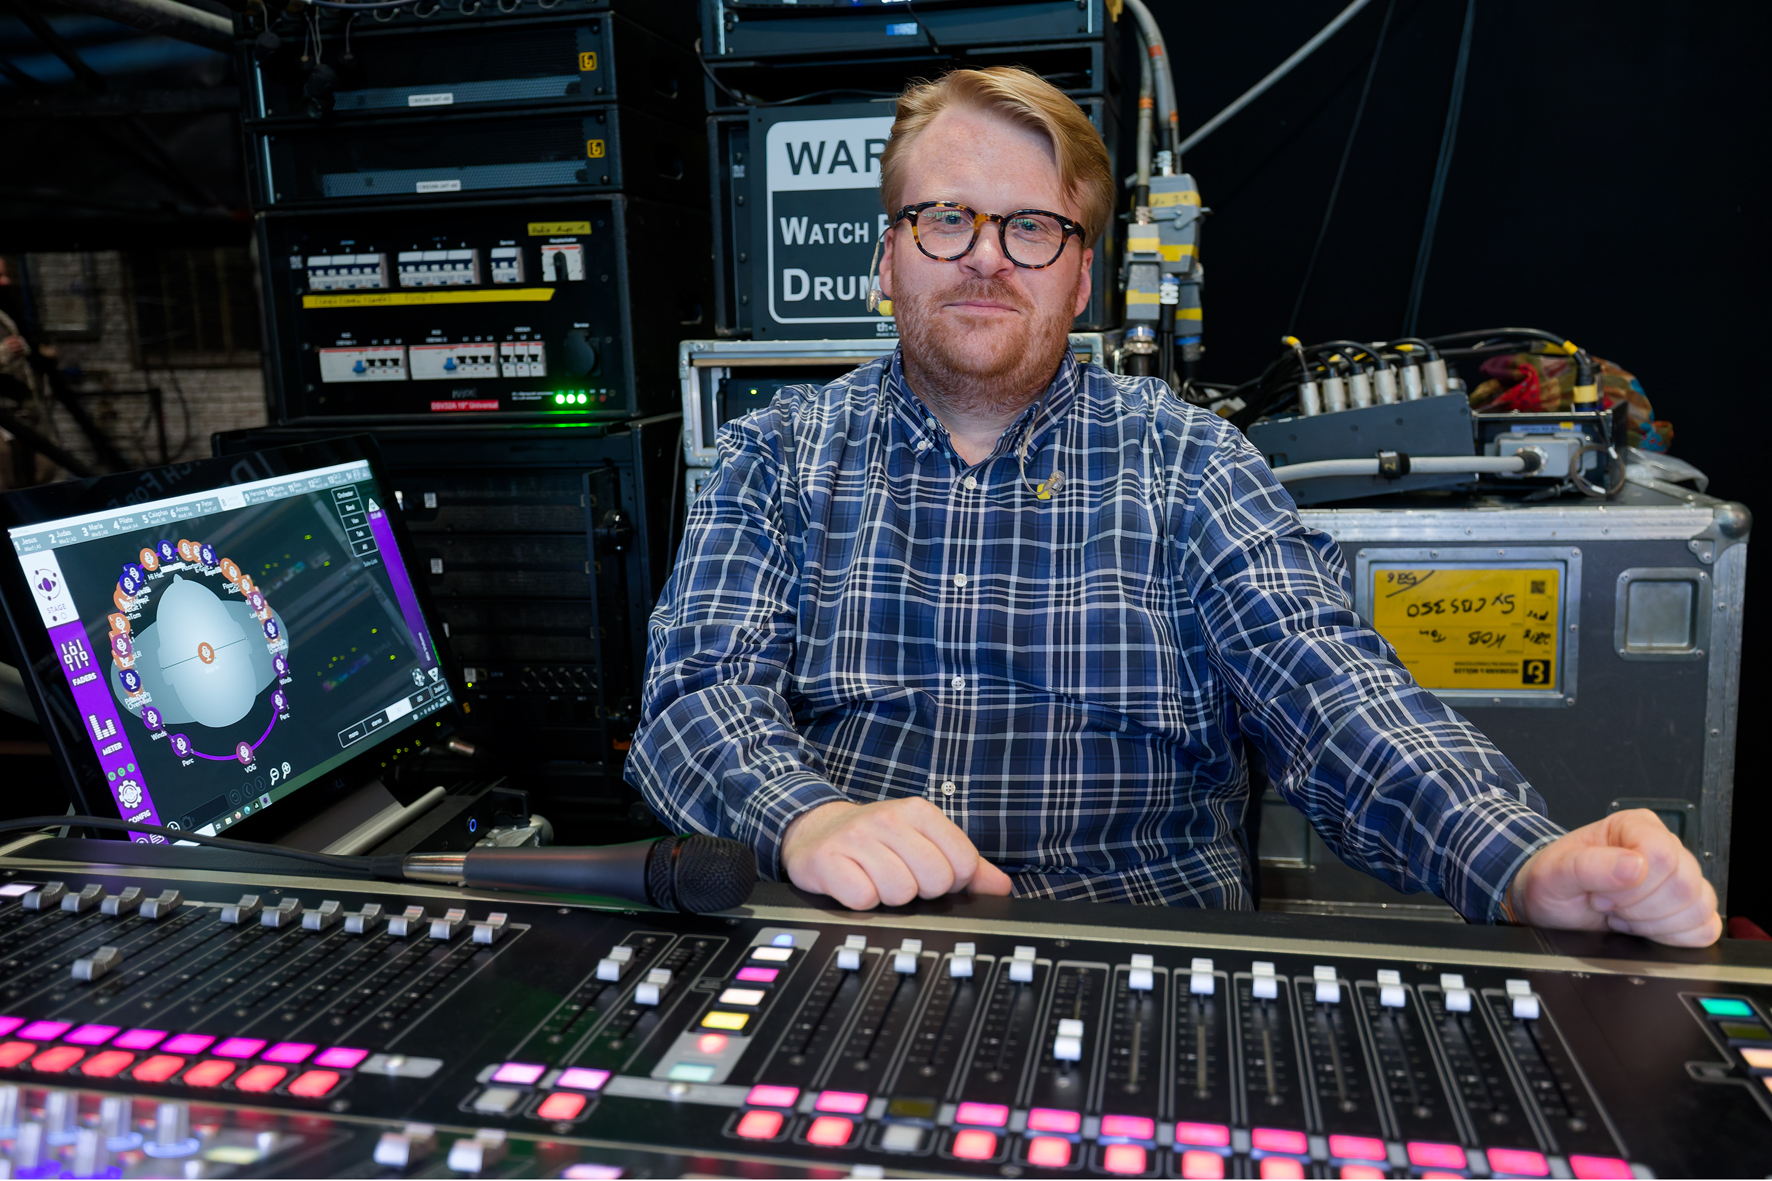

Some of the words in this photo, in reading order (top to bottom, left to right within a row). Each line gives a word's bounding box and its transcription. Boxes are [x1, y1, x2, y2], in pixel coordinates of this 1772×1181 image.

[780, 215, 869, 246] WATCH
[196, 503, 203, 513] 7
[170, 509, 177, 518] 6
[141, 514, 149, 524] 5
[112, 520, 121, 530] 4
[81, 527, 89, 537] 3
[48, 534, 57, 544] 2
[47, 603, 67, 615] STAGE
[72, 673, 97, 687] FADERS
[102, 742, 123, 756] METER
[181, 758, 195, 768] Perc
[244, 764, 257, 774] VOG
